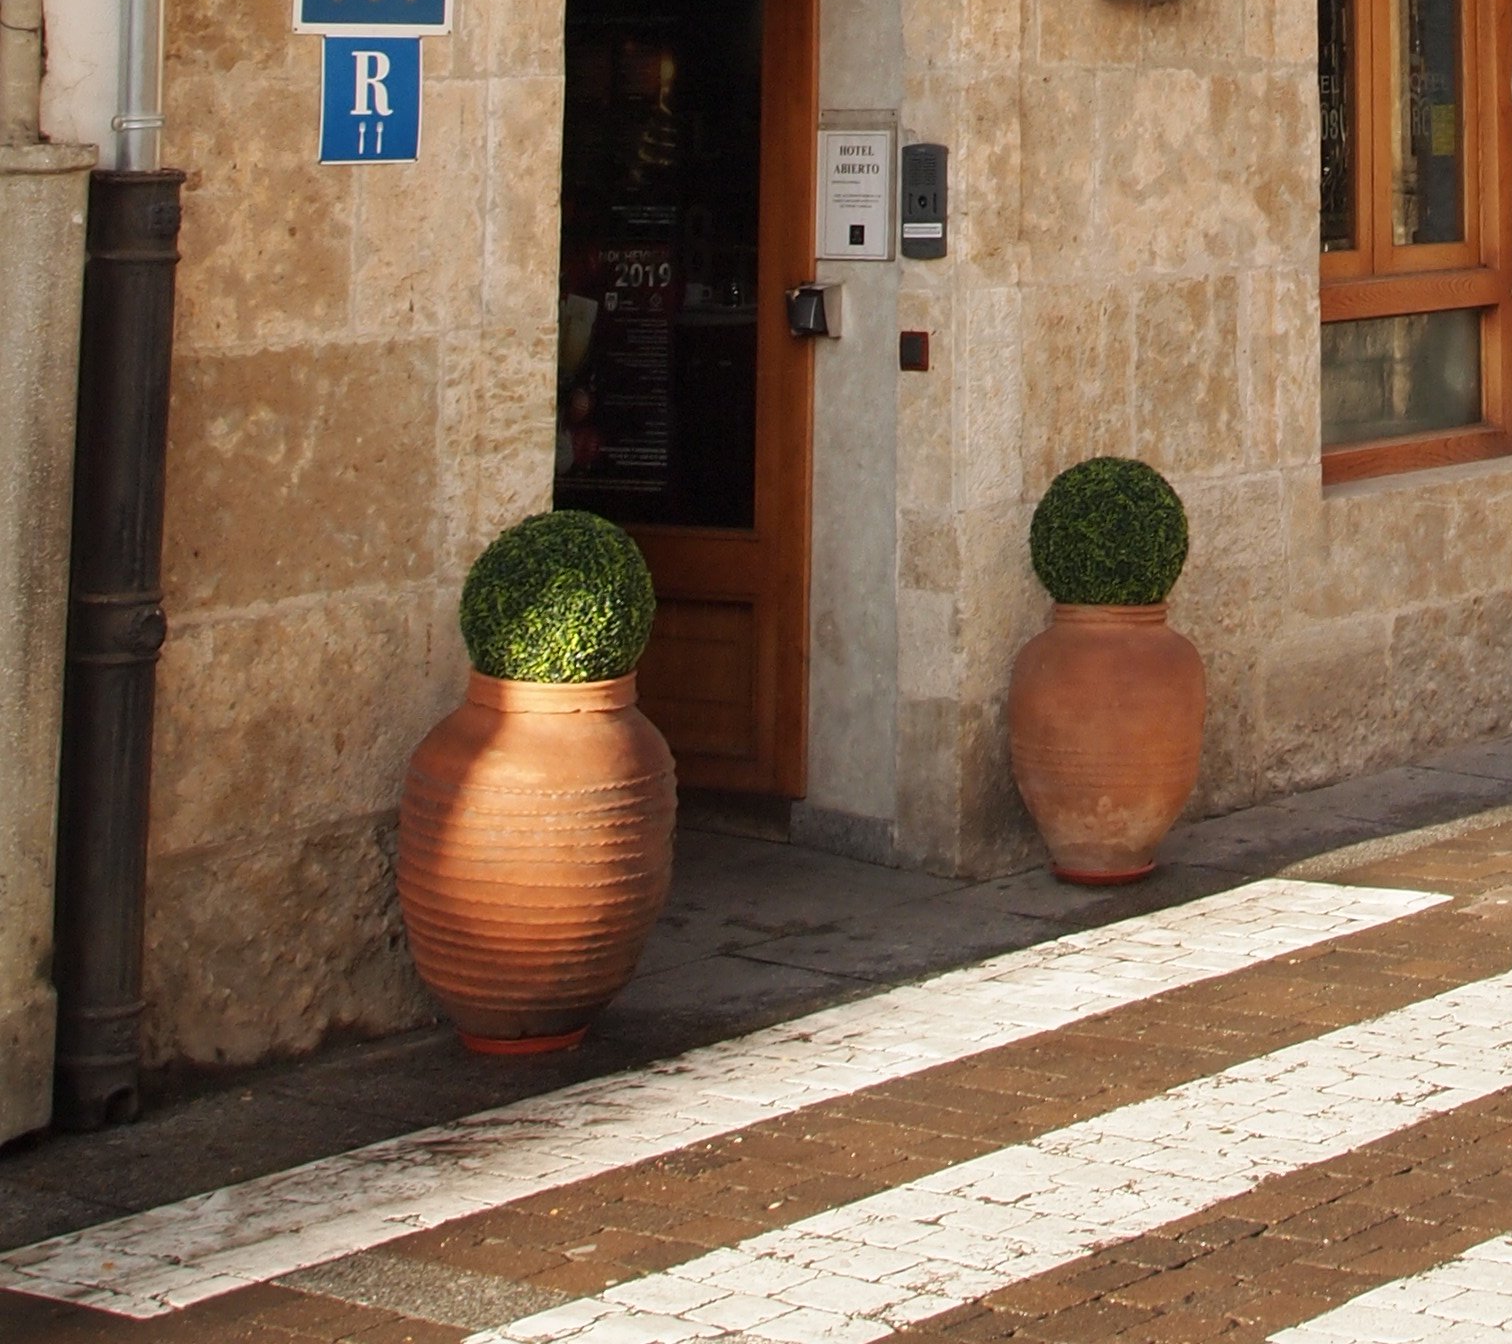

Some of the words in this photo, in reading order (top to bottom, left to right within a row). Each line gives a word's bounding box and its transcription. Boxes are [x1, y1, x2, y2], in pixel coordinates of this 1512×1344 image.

[349, 50, 394, 117] R
[839, 145, 875, 157] HOTEL
[833, 164, 880, 175] ABIERTO
[614, 262, 671, 288] 2019
